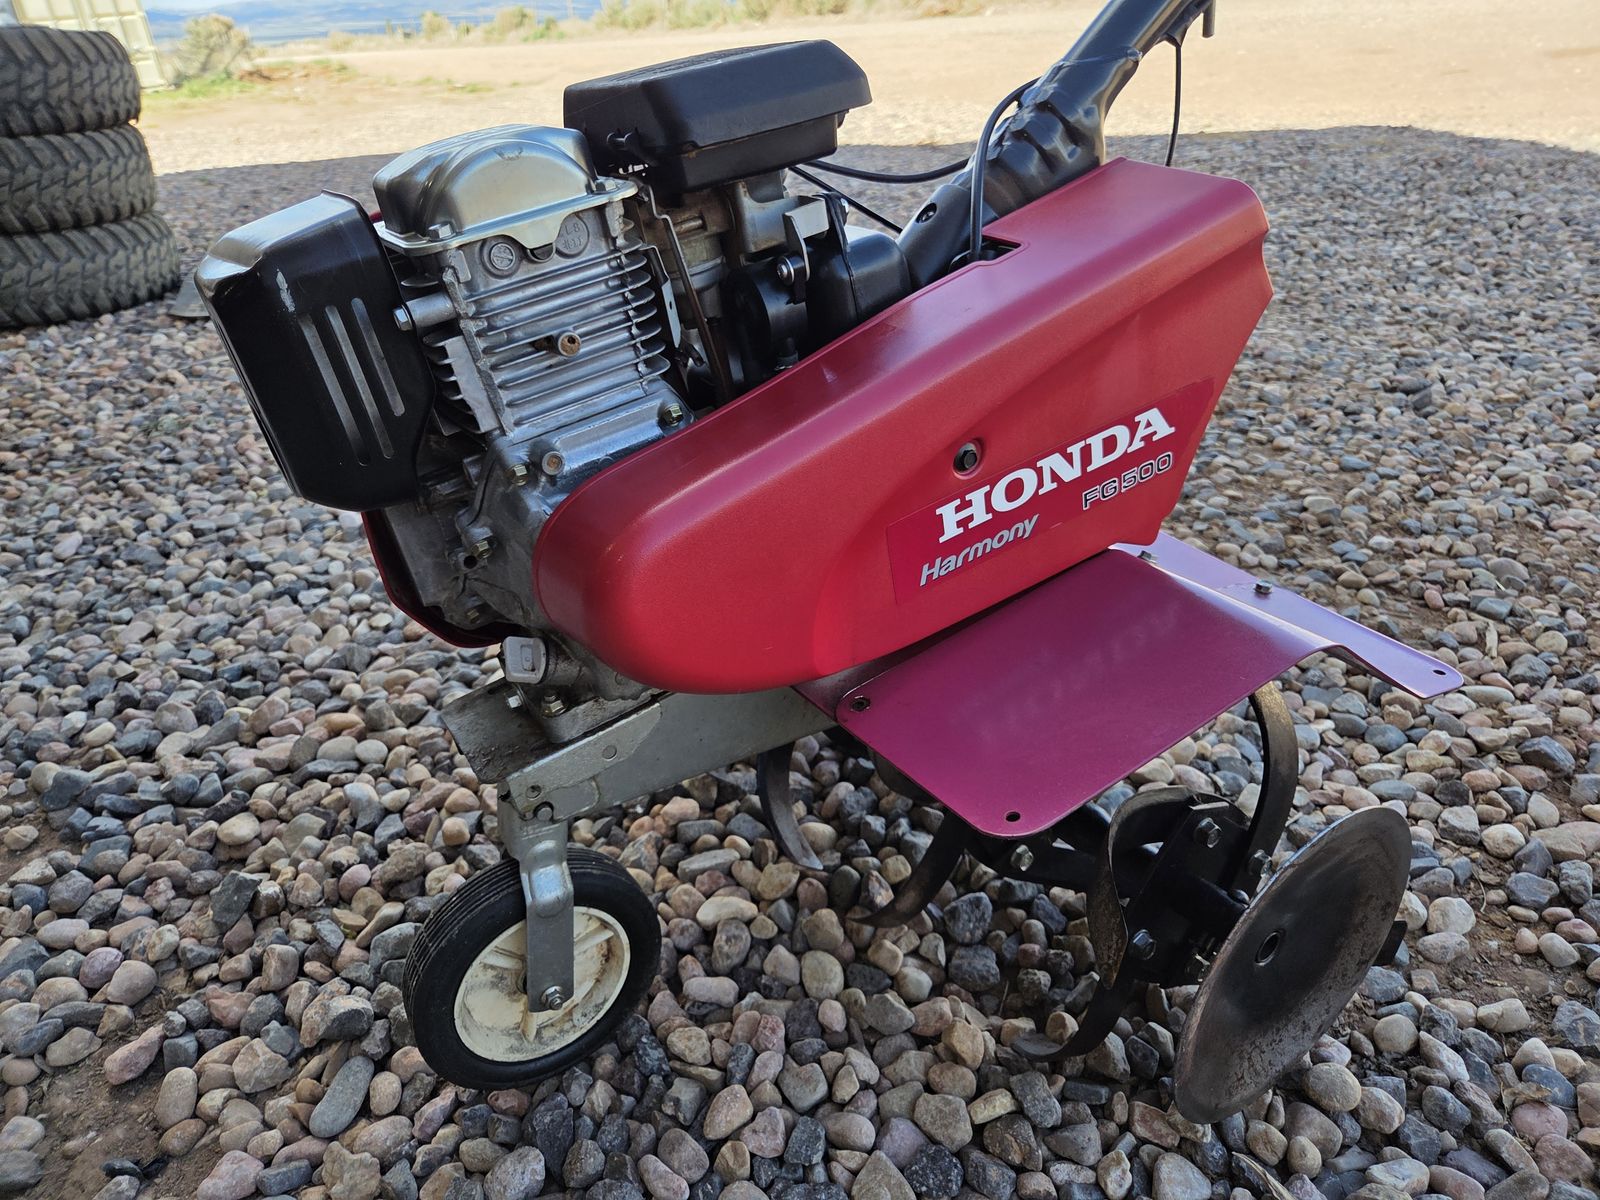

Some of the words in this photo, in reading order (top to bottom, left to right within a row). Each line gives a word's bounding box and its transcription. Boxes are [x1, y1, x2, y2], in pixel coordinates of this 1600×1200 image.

[936, 407, 1175, 543] HONDA
[1082, 452, 1173, 510] FG500
[920, 514, 1040, 586] Harmony
